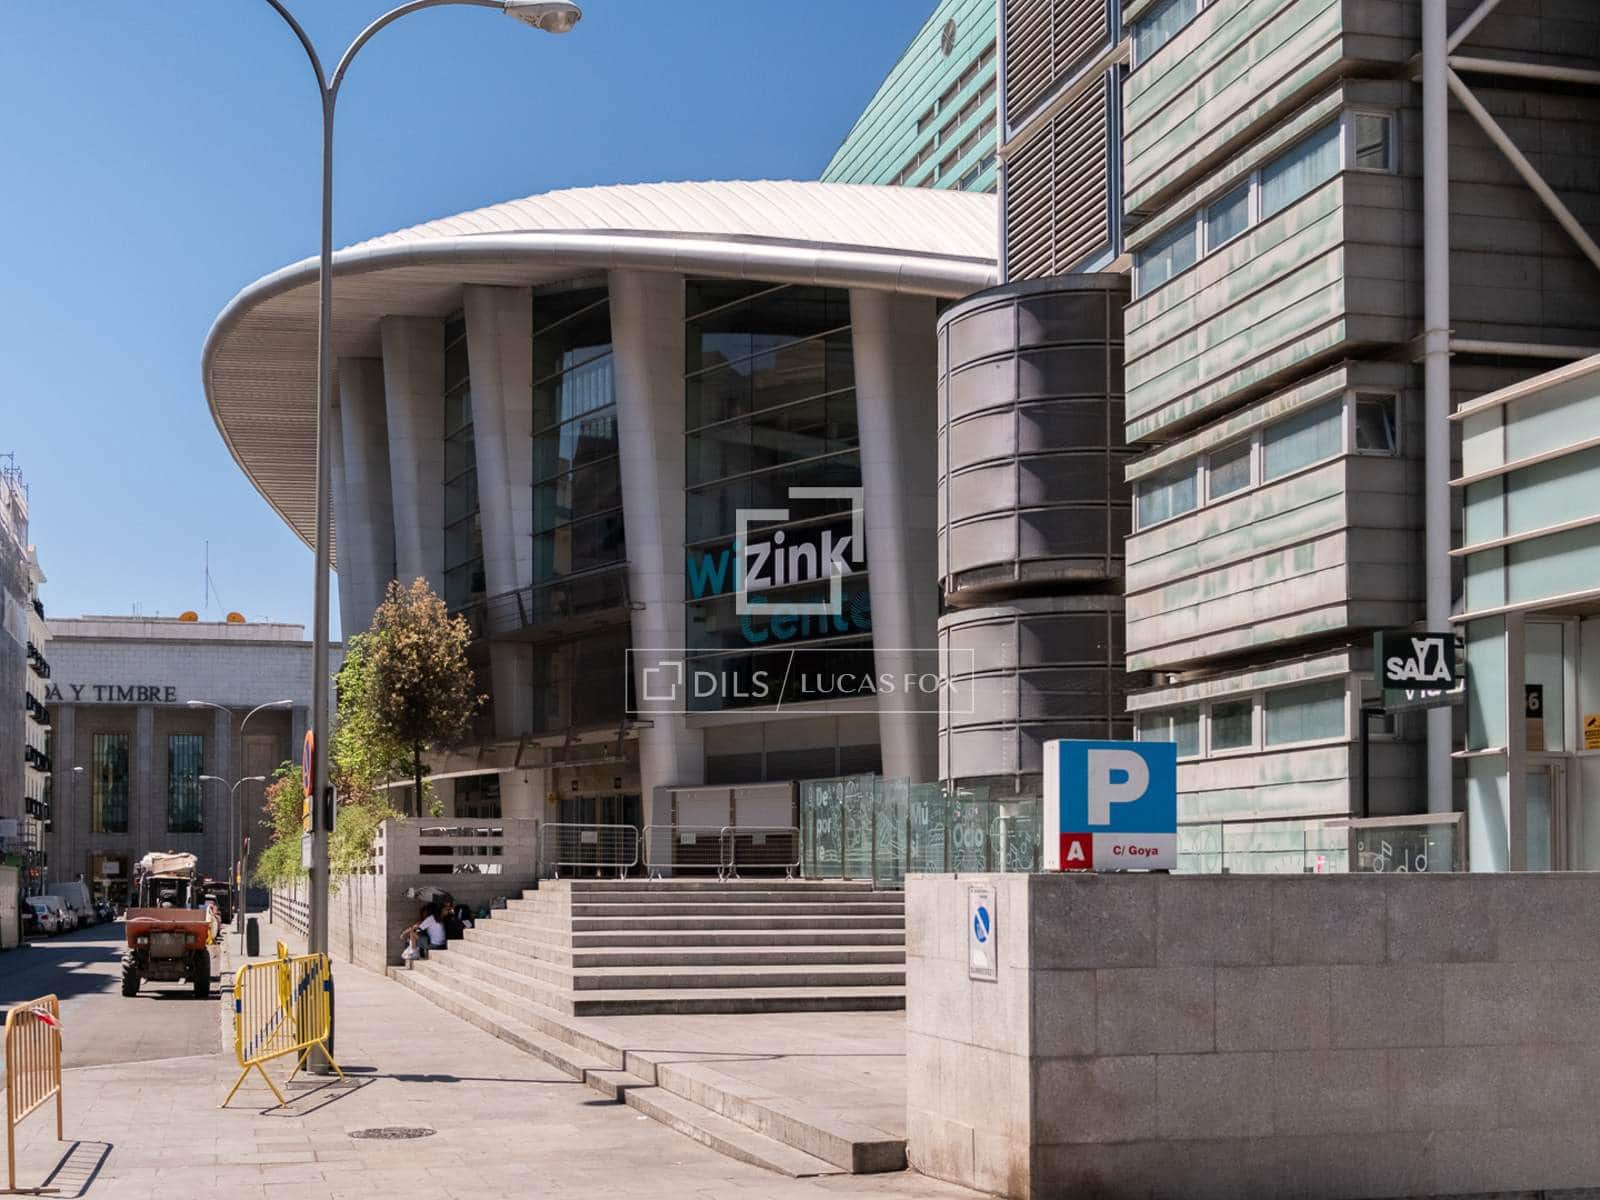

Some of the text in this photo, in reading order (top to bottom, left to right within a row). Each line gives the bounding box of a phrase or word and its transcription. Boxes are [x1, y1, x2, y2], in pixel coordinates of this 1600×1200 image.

[69, 684, 85, 701] Y
[92, 685, 177, 703] TIMBRE
[1528, 691, 1540, 711] 6
[1087, 749, 1149, 826] P
[1066, 840, 1086, 861] A
[1112, 845, 1159, 859] C/ Goya
